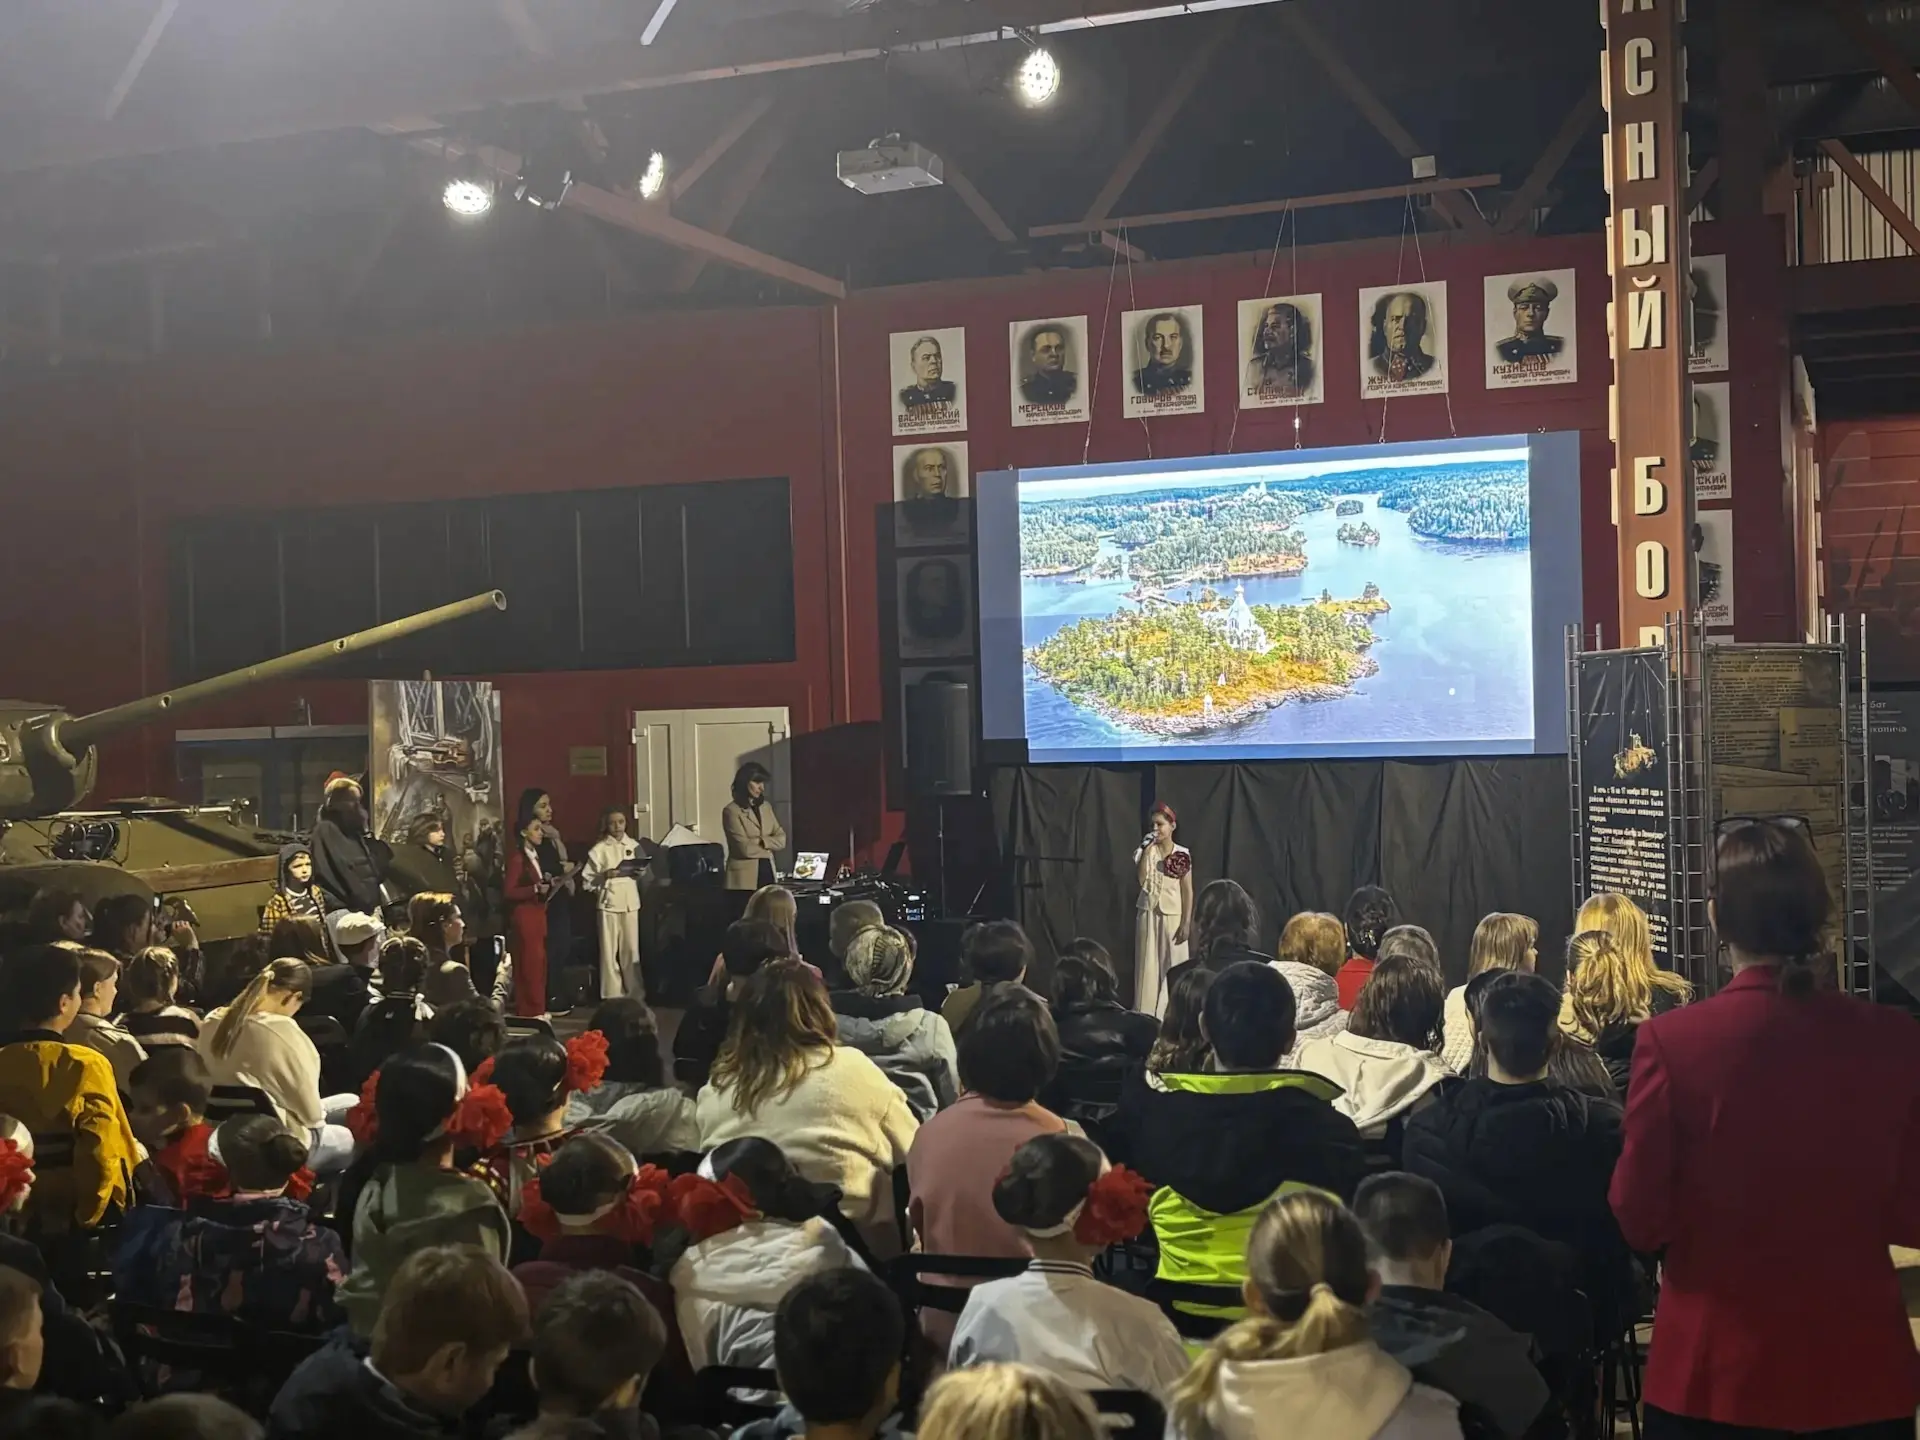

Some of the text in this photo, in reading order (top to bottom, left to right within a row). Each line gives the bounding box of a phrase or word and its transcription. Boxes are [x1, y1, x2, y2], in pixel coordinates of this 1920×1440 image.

[1621, 0, 1666, 350] СНЫЙ
[1493, 360, 1546, 374] КУЗНЕЦОВ
[1368, 375, 1403, 385] ЖУКО
[1130, 394, 1172, 405] ГОВОРОВ
[898, 408, 960, 423] ВАСИЛЕВСКИЙ
[1018, 404, 1066, 414] МЕРЕЦКОВ
[1696, 472, 1727, 485] СКИЙ
